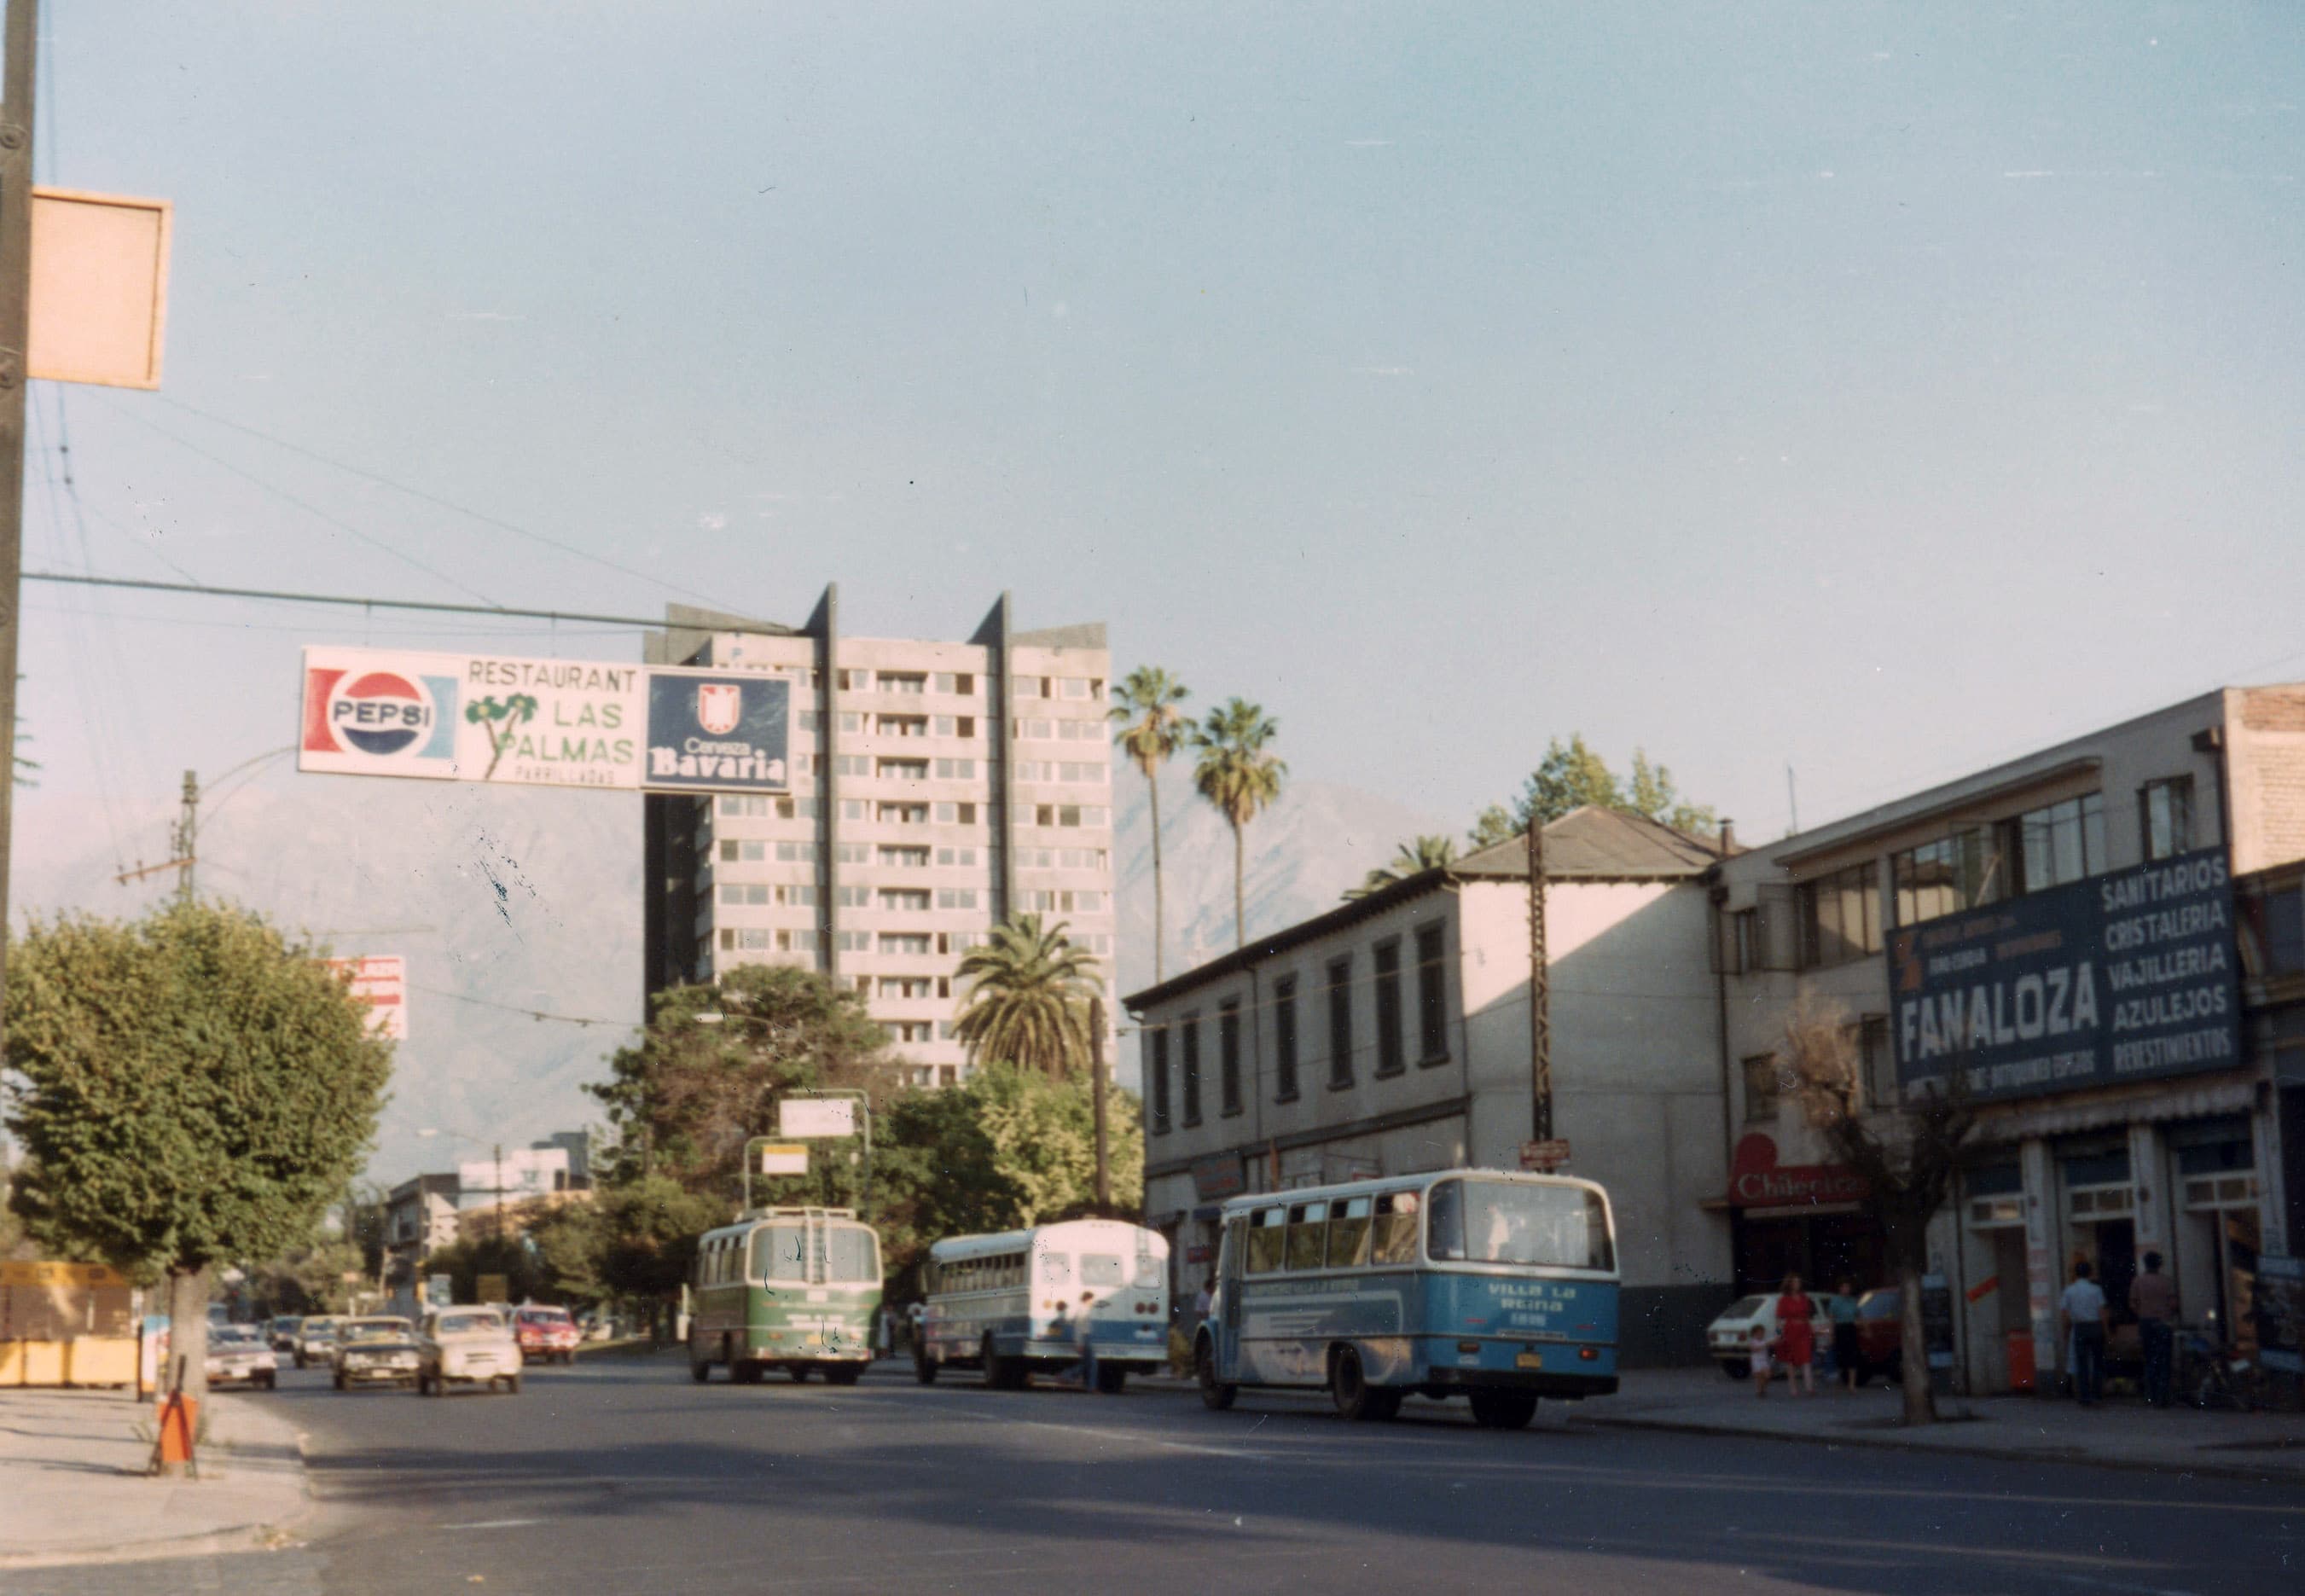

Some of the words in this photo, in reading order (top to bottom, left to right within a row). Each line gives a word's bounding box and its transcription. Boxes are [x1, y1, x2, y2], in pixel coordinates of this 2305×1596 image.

[468, 660, 636, 694] RESTAURANT
[333, 701, 430, 727] PEPSI
[554, 699, 623, 729] LAS
[497, 730, 634, 765] PALMAS
[648, 746, 786, 781] Bavaria
[2102, 857, 2226, 912] SANITARIOS
[2105, 901, 2226, 951] CRISTALERIA
[2108, 942, 2227, 991] VAJILLERIA
[1901, 961, 2099, 1063] FANALOZA
[2113, 986, 2227, 1032] AZULEJOS
